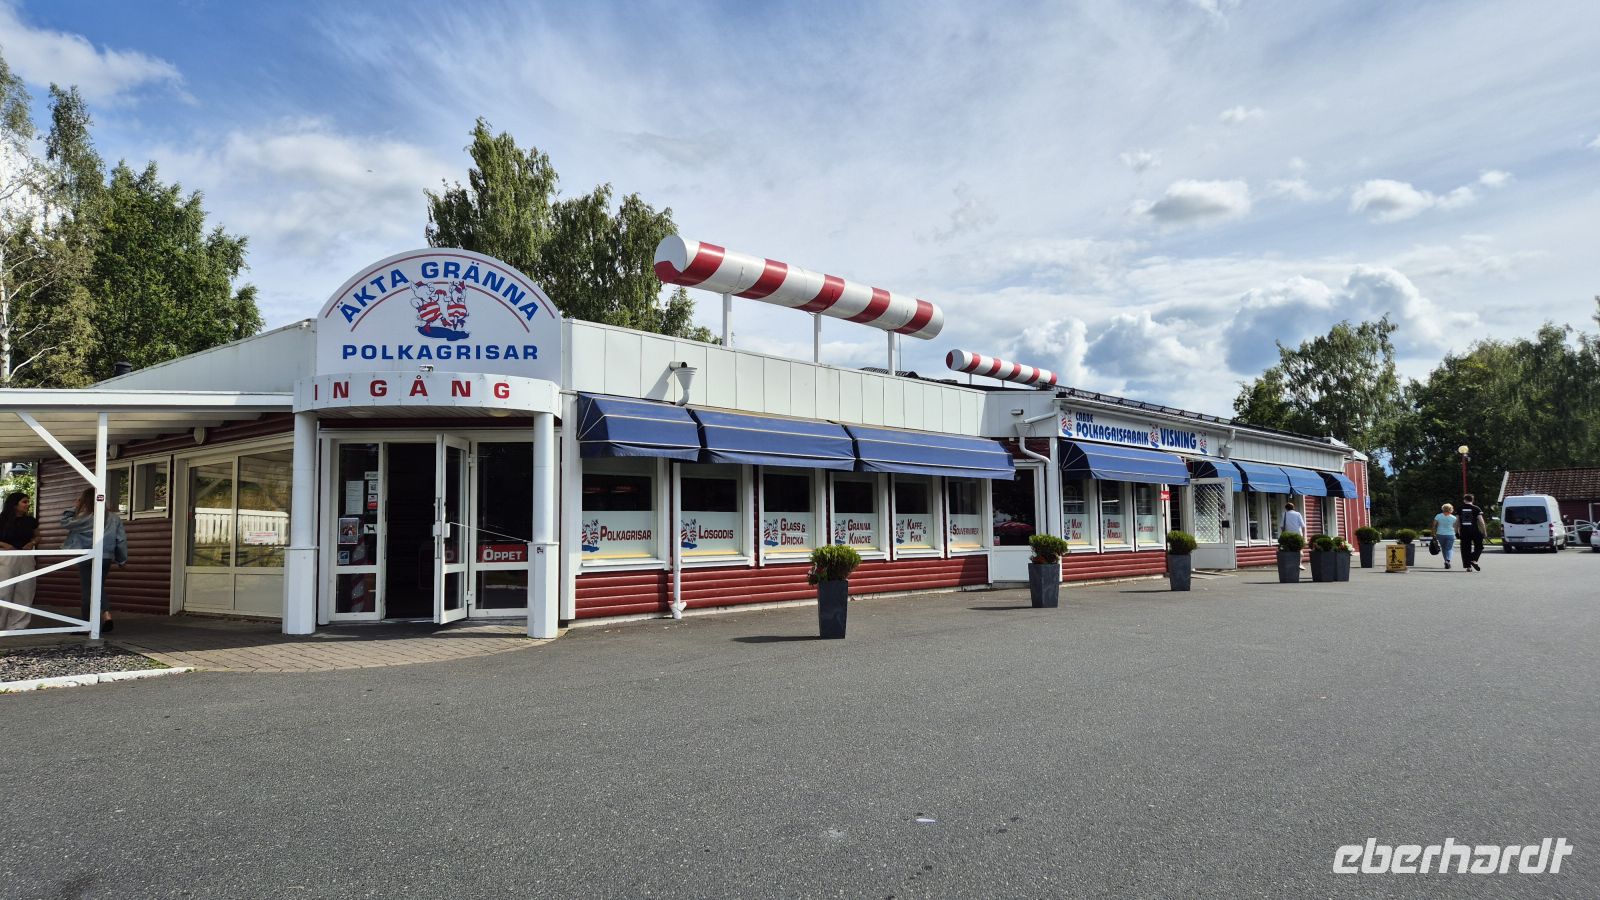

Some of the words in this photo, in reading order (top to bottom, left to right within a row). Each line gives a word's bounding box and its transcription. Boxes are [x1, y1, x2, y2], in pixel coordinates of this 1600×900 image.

[336, 268, 409, 324] ÄKTA
[421, 261, 539, 322] GRÄNNA
[342, 344, 538, 360] POLKAGRISAR
[314, 375, 510, 401] INGÅNG
[1076, 422, 1149, 445] POLKAGRISFABRIK
[1160, 427, 1197, 449] VISNING
[780, 518, 801, 532] GLASS
[907, 518, 923, 531] KAFFE
[599, 525, 652, 541] POLKAGRISAR
[780, 533, 804, 546] DRICKA
[483, 546, 523, 561] ÖPPET
